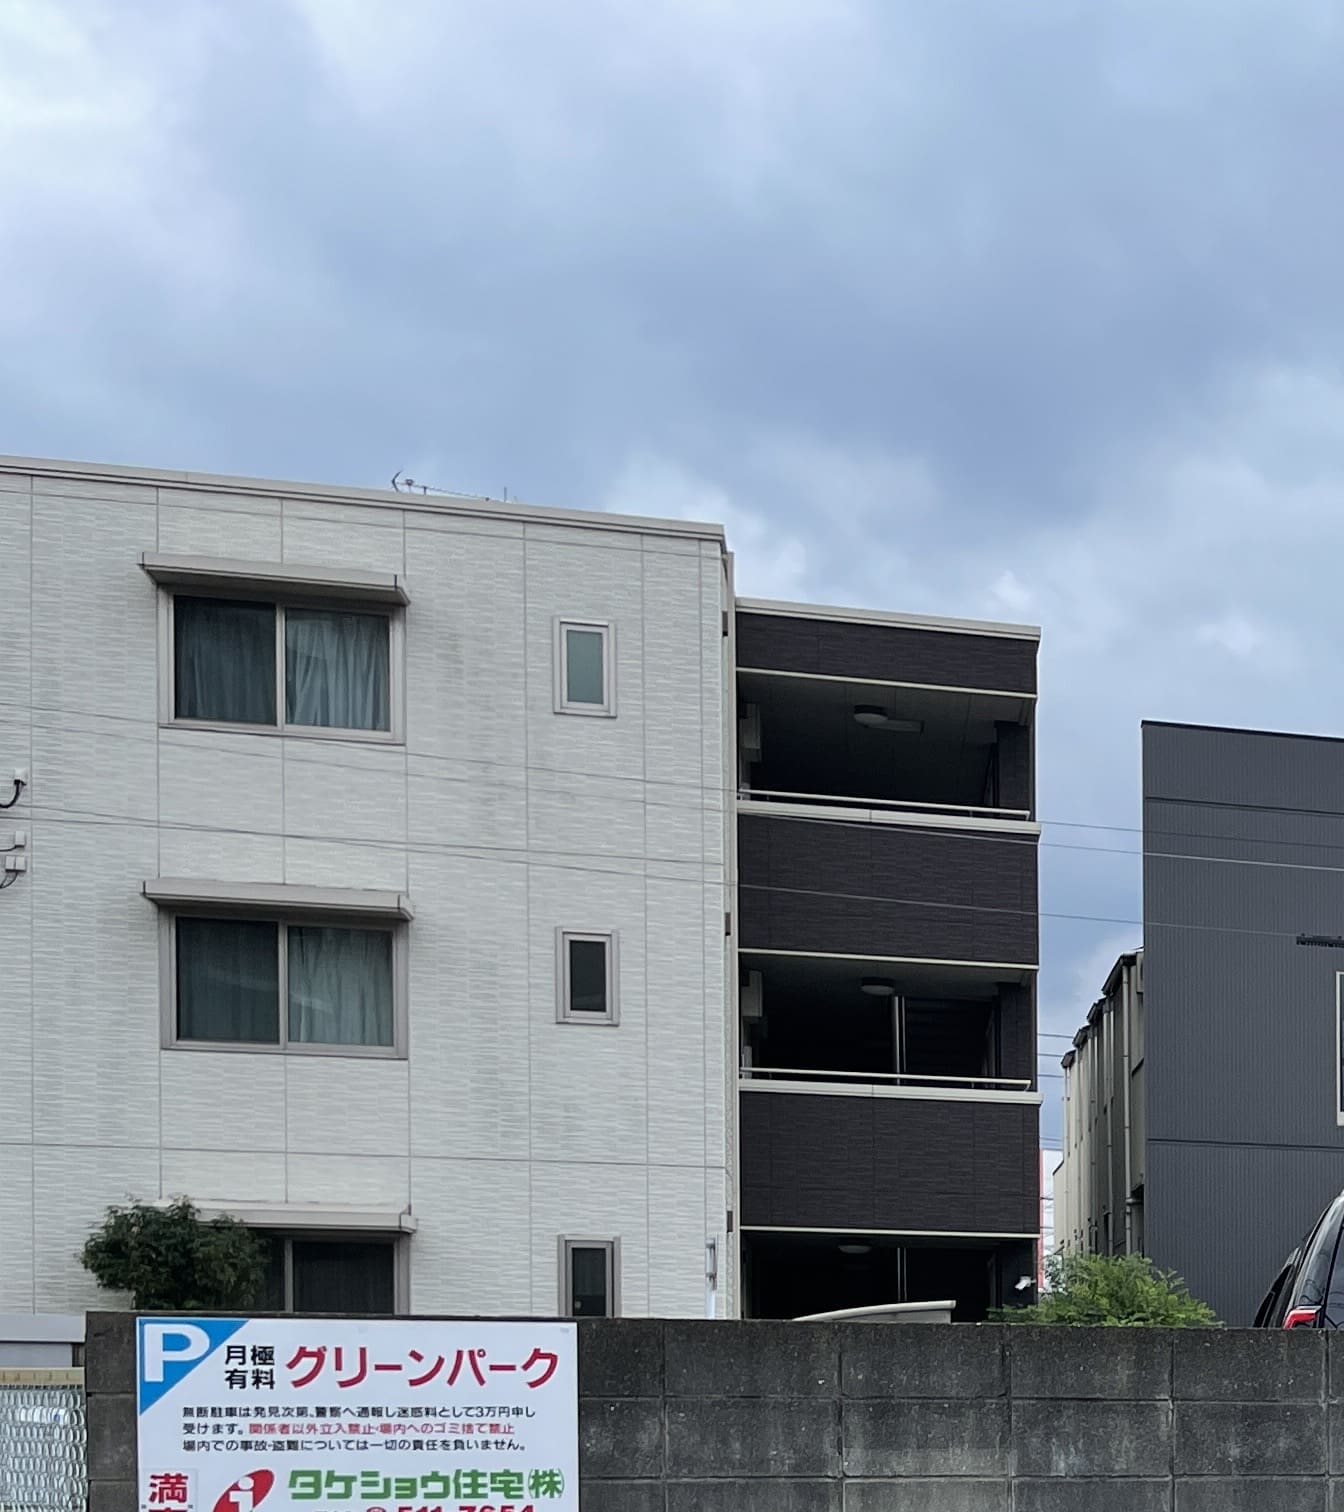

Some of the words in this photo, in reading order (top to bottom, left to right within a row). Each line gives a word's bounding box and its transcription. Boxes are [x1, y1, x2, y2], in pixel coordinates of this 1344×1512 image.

[144, 1323, 210, 1383] P
[225, 1345, 276, 1366] 月極
[285, 1345, 559, 1389] グリーンパーク
[224, 1368, 276, 1390] 有料
